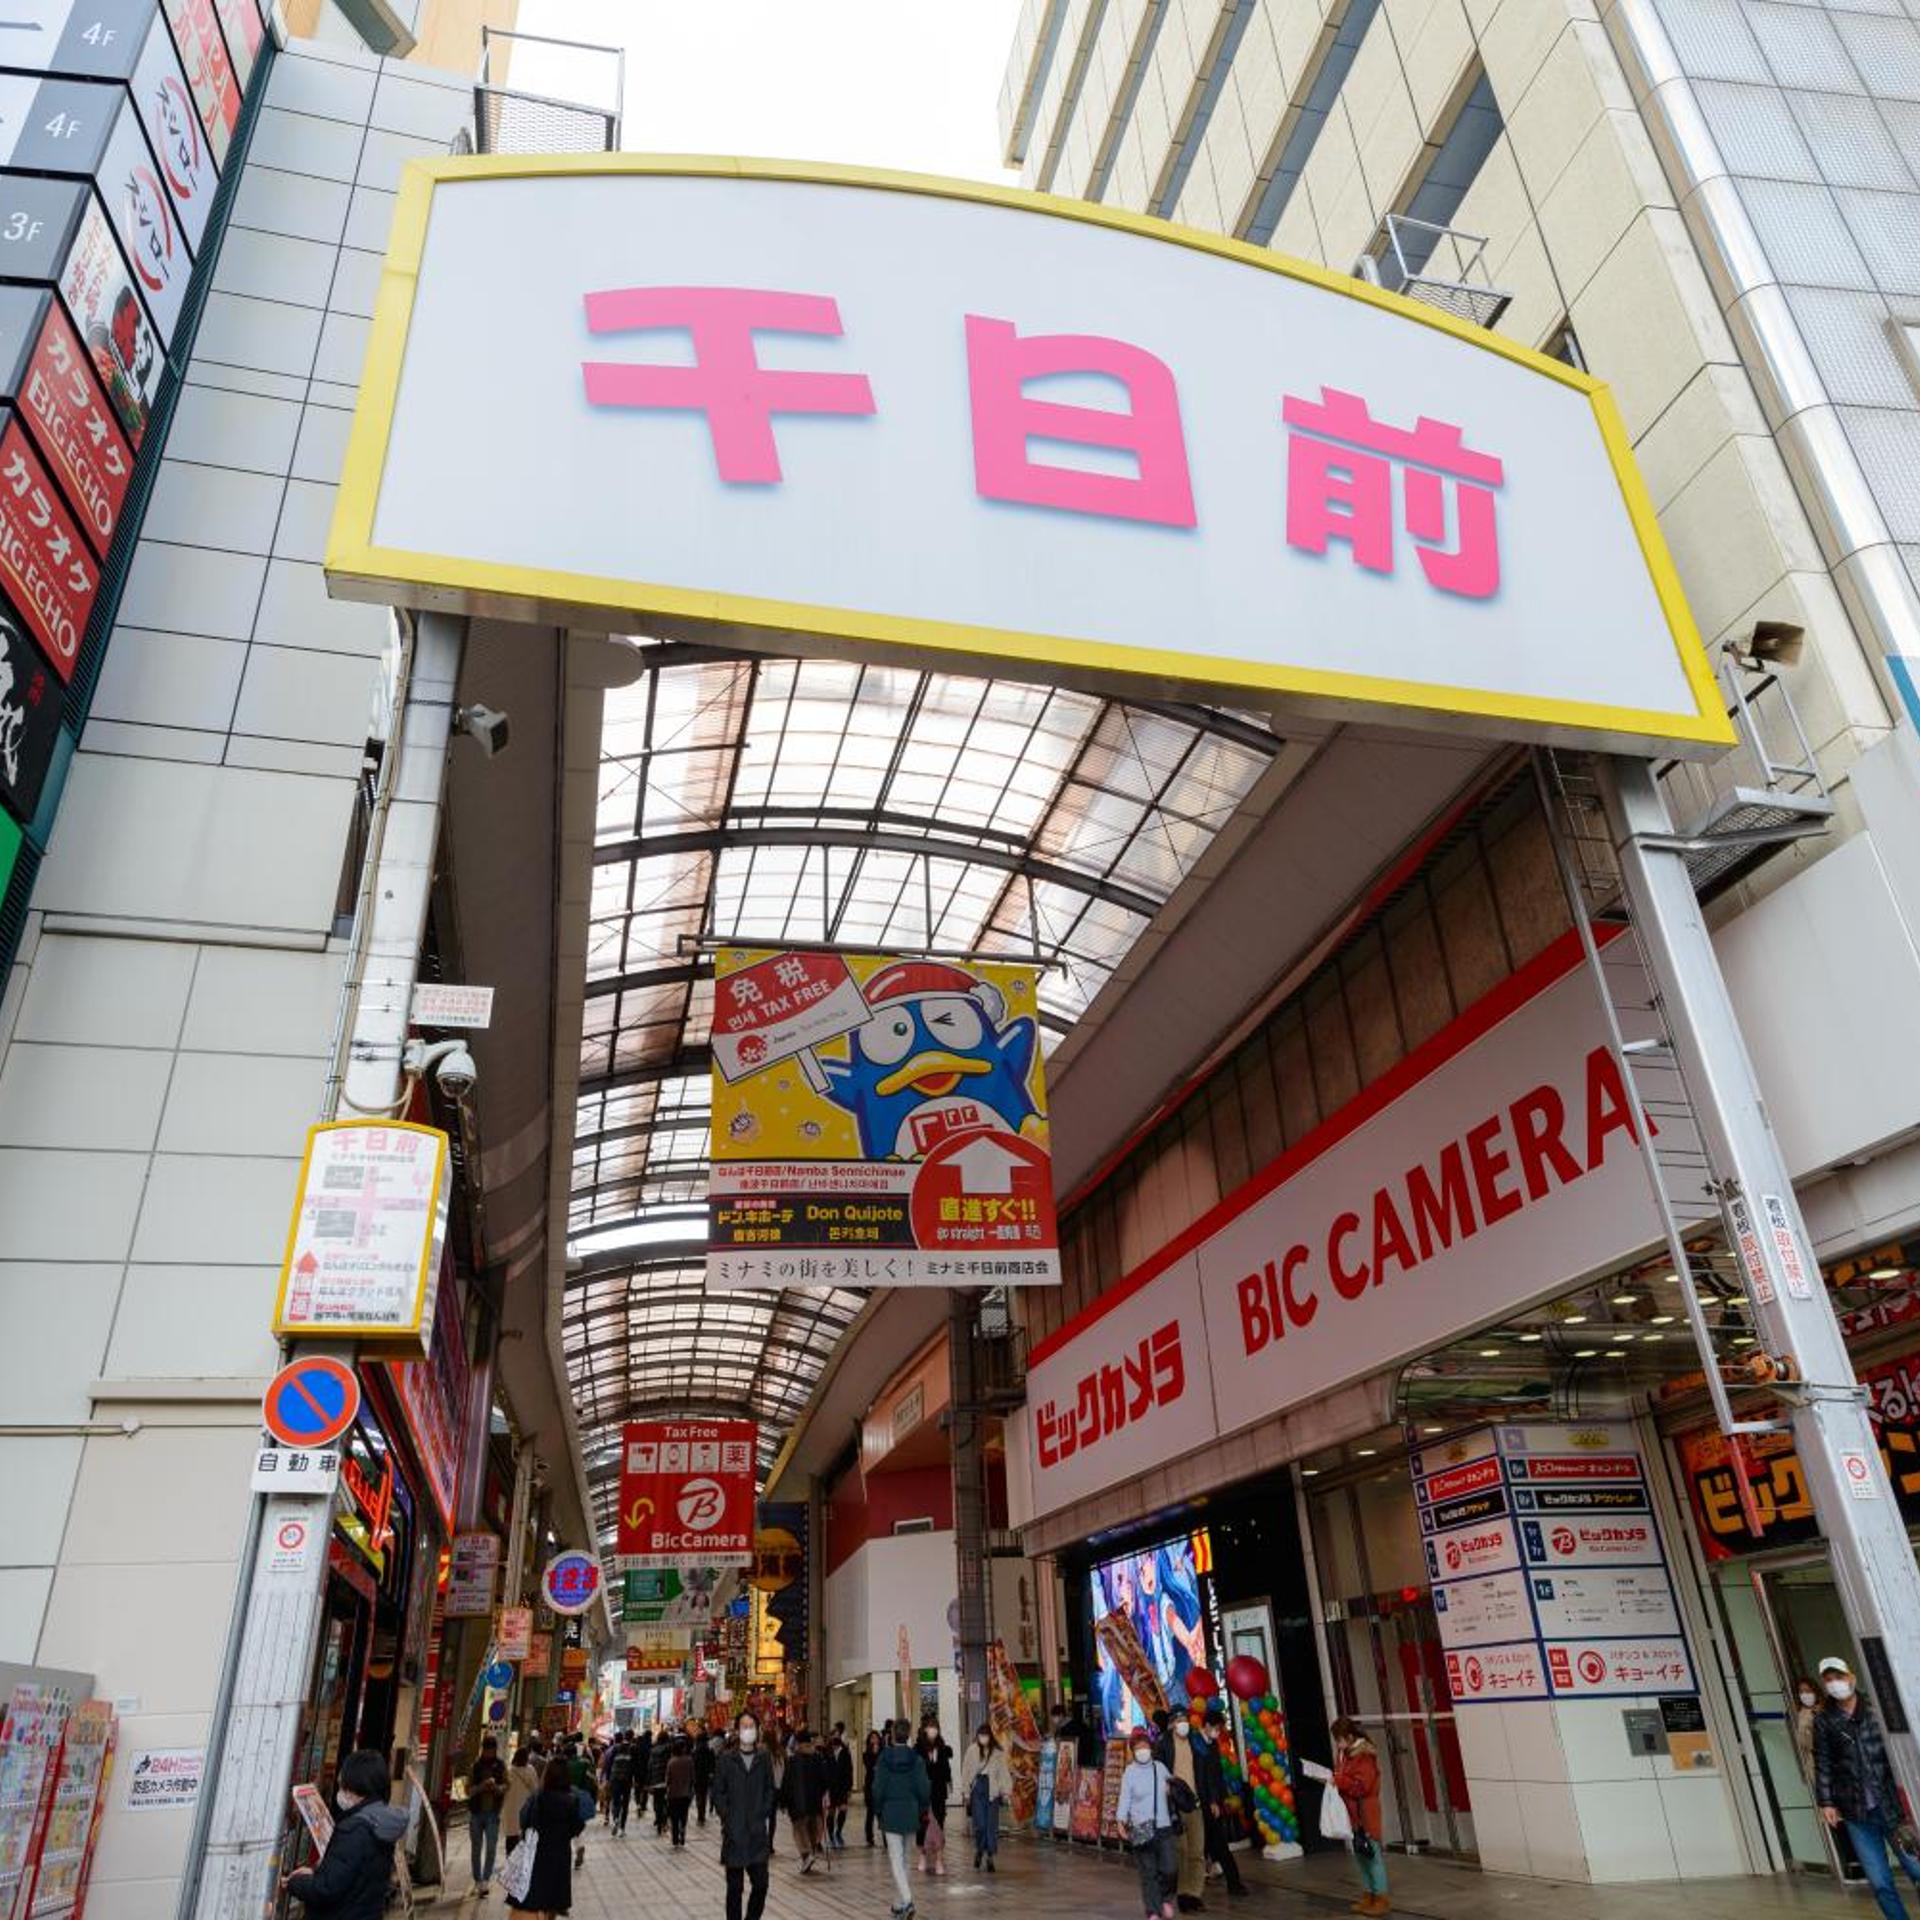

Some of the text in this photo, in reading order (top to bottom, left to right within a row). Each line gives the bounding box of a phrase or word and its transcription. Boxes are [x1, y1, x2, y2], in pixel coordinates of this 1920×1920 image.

[82, 22, 117, 47] 4F
[45, 112, 82, 139] 4F
[3, 212, 43, 243] 3F
[48, 331, 125, 475] カラオケ
[28, 371, 67, 447] BIG
[67, 441, 112, 536] ECHO
[581, 286, 1504, 598] 千日前
[3, 452, 91, 592] カラオケ
[25, 562, 76, 658] ECHO
[730, 957, 810, 1008] 免税
[761, 995, 791, 1018] TAX
[793, 979, 832, 1005] FREE
[331, 1129, 420, 1154] 千日前
[806, 1205, 904, 1222] Don Quijote
[1236, 1044, 1660, 1357] BIC CAMERA
[926, 1260, 1050, 1277] ミナミ千日前商店会
[1035, 1319, 1186, 1471] ビックカメラ
[664, 1426, 719, 1438] Tax Free
[258, 1452, 337, 1472] 自動車
[650, 1532, 748, 1550] BicCamera
[1579, 1527, 1647, 1541] ビックカメラ
[1488, 1668, 1537, 1689] キョーイチ
[1615, 1664, 1685, 1682] キョーイチ
[132, 1777, 198, 1795] 防犯カメラ作動中
